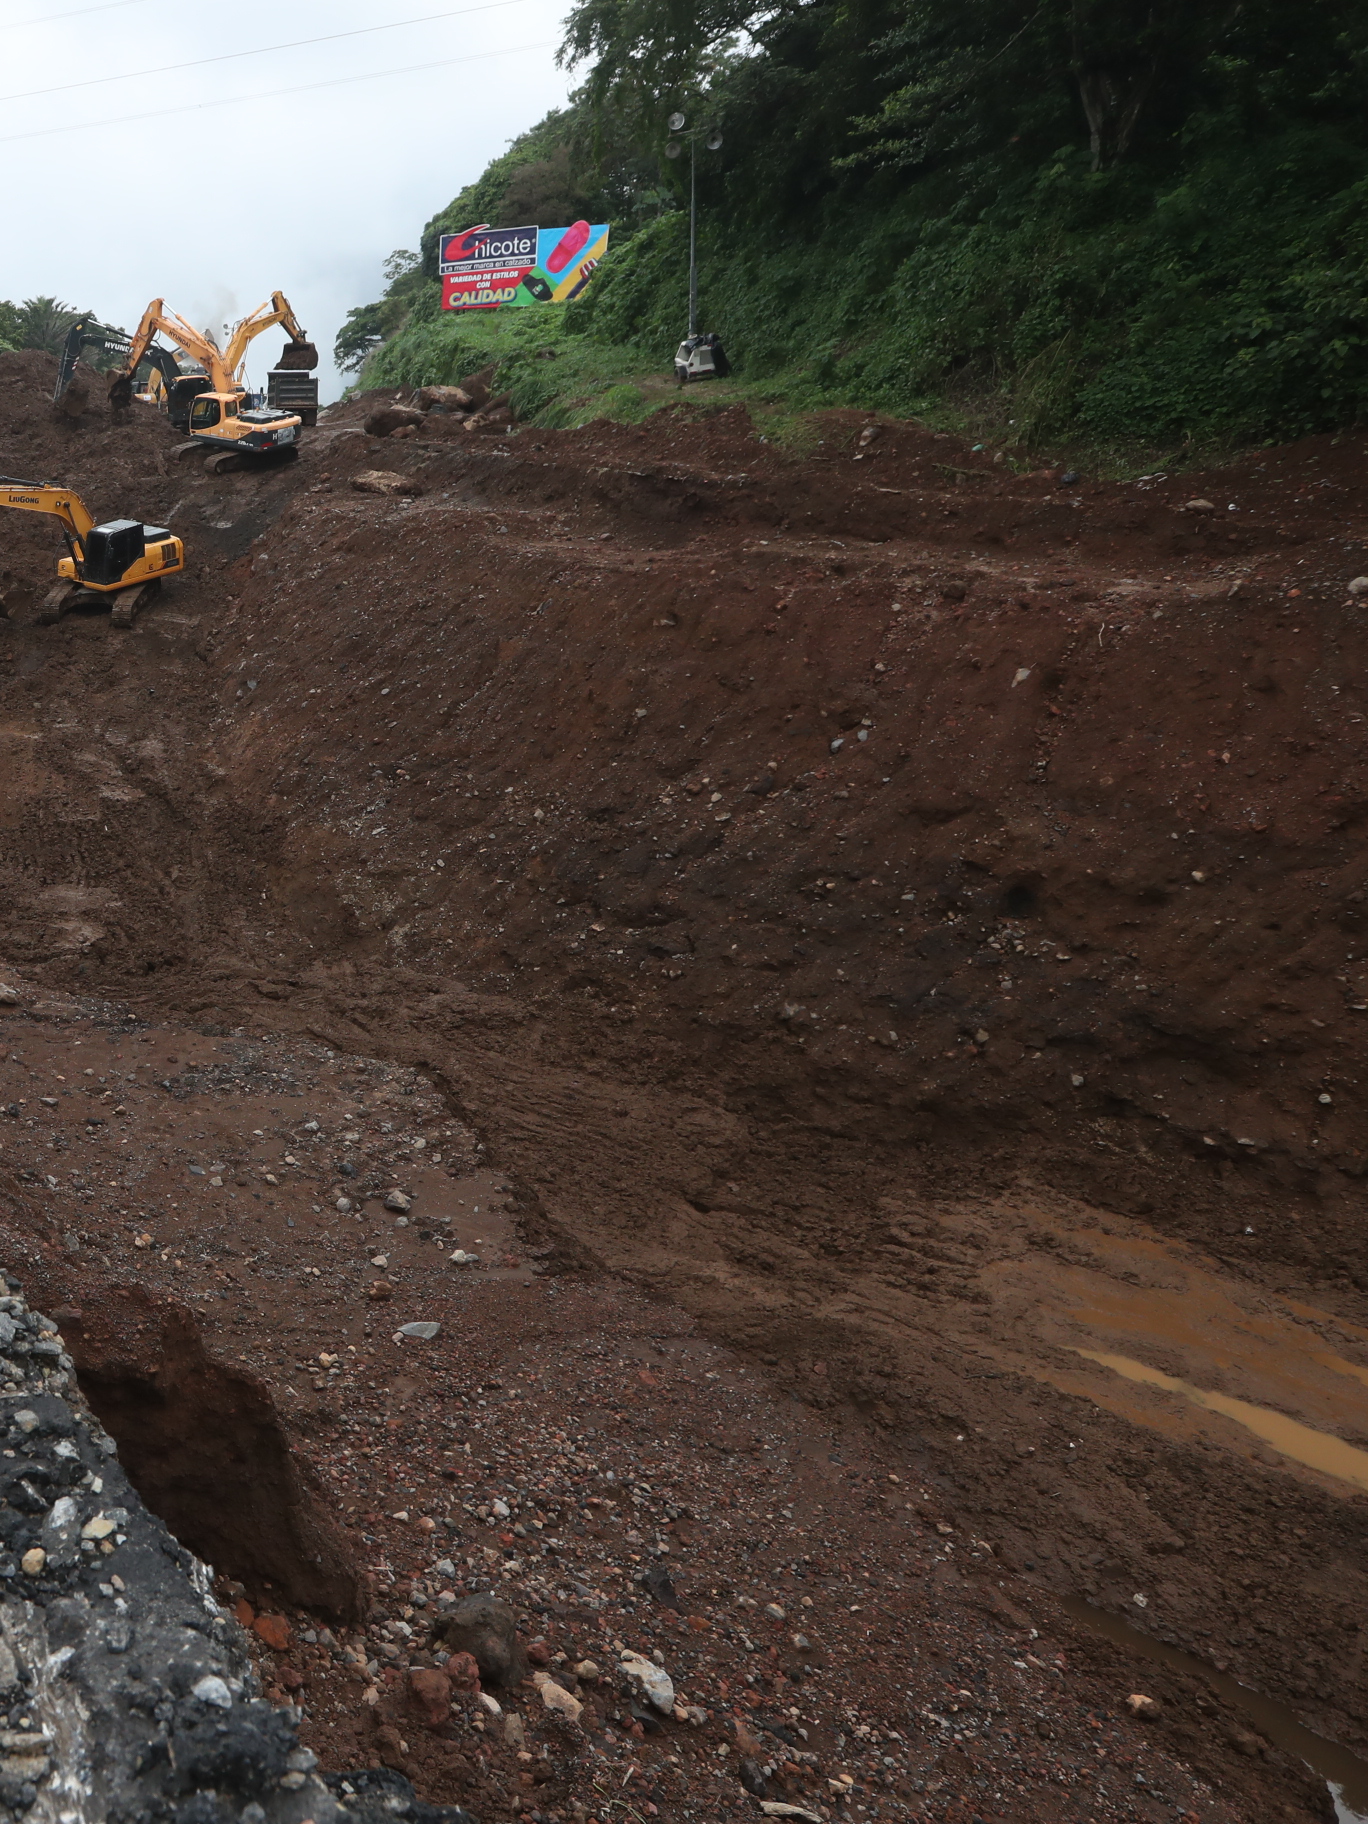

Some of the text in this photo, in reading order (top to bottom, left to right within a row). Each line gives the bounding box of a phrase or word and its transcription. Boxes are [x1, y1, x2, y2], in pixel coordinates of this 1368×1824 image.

[444, 224, 530, 260] Chicote
[454, 264, 473, 272] mejor
[504, 258, 531, 266] calzado
[450, 274, 482, 283] VARIEDAD
[493, 271, 518, 279] ESTILOS
[449, 288, 516, 306] CALIDAD
[104, 341, 135, 353] HYUNDA
[169, 330, 191, 348] HYUNDAI
